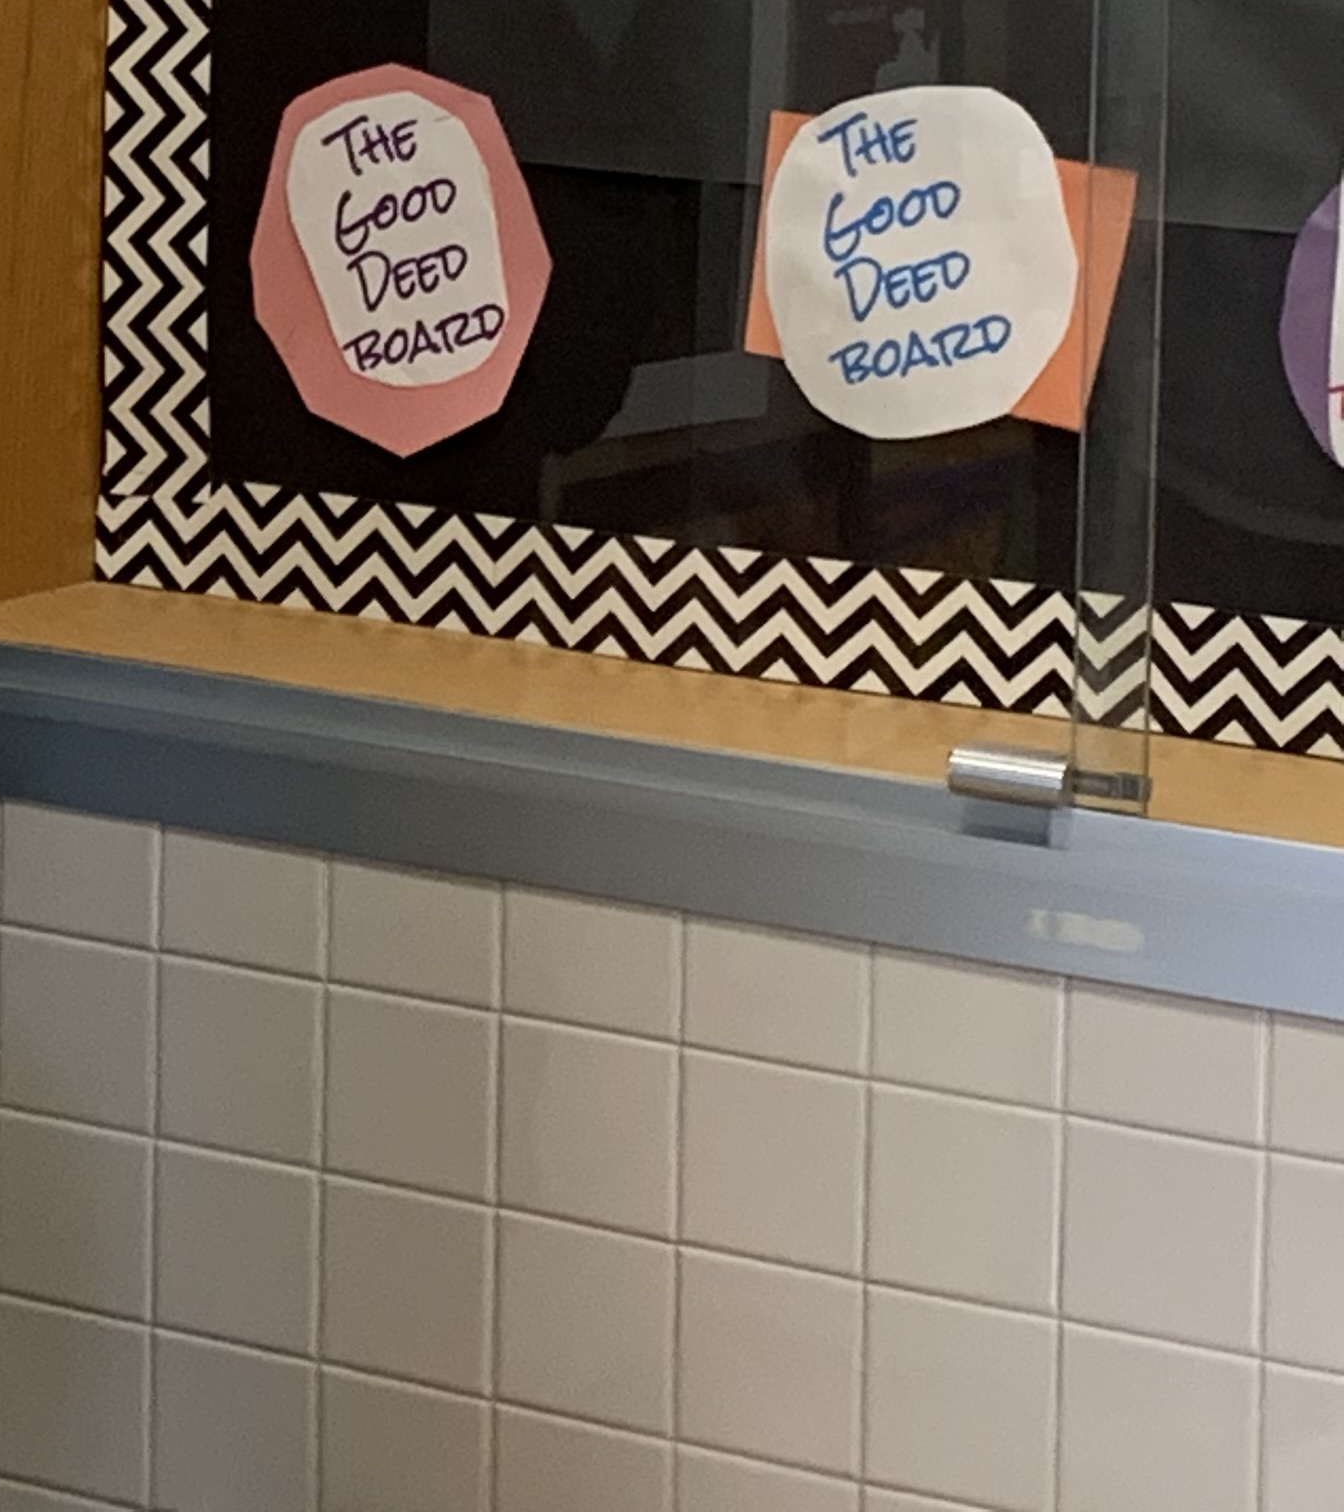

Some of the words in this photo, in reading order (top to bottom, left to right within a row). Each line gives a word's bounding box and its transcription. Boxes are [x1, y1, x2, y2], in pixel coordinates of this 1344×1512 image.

[321, 115, 418, 176] THE
[817, 112, 918, 177] THE
[335, 178, 457, 256] GOOD
[824, 181, 960, 261] GOOD
[347, 244, 467, 312] DEED
[834, 250, 970, 322] DEED
[342, 304, 504, 371] BOARD
[828, 314, 1012, 384] BOARD
